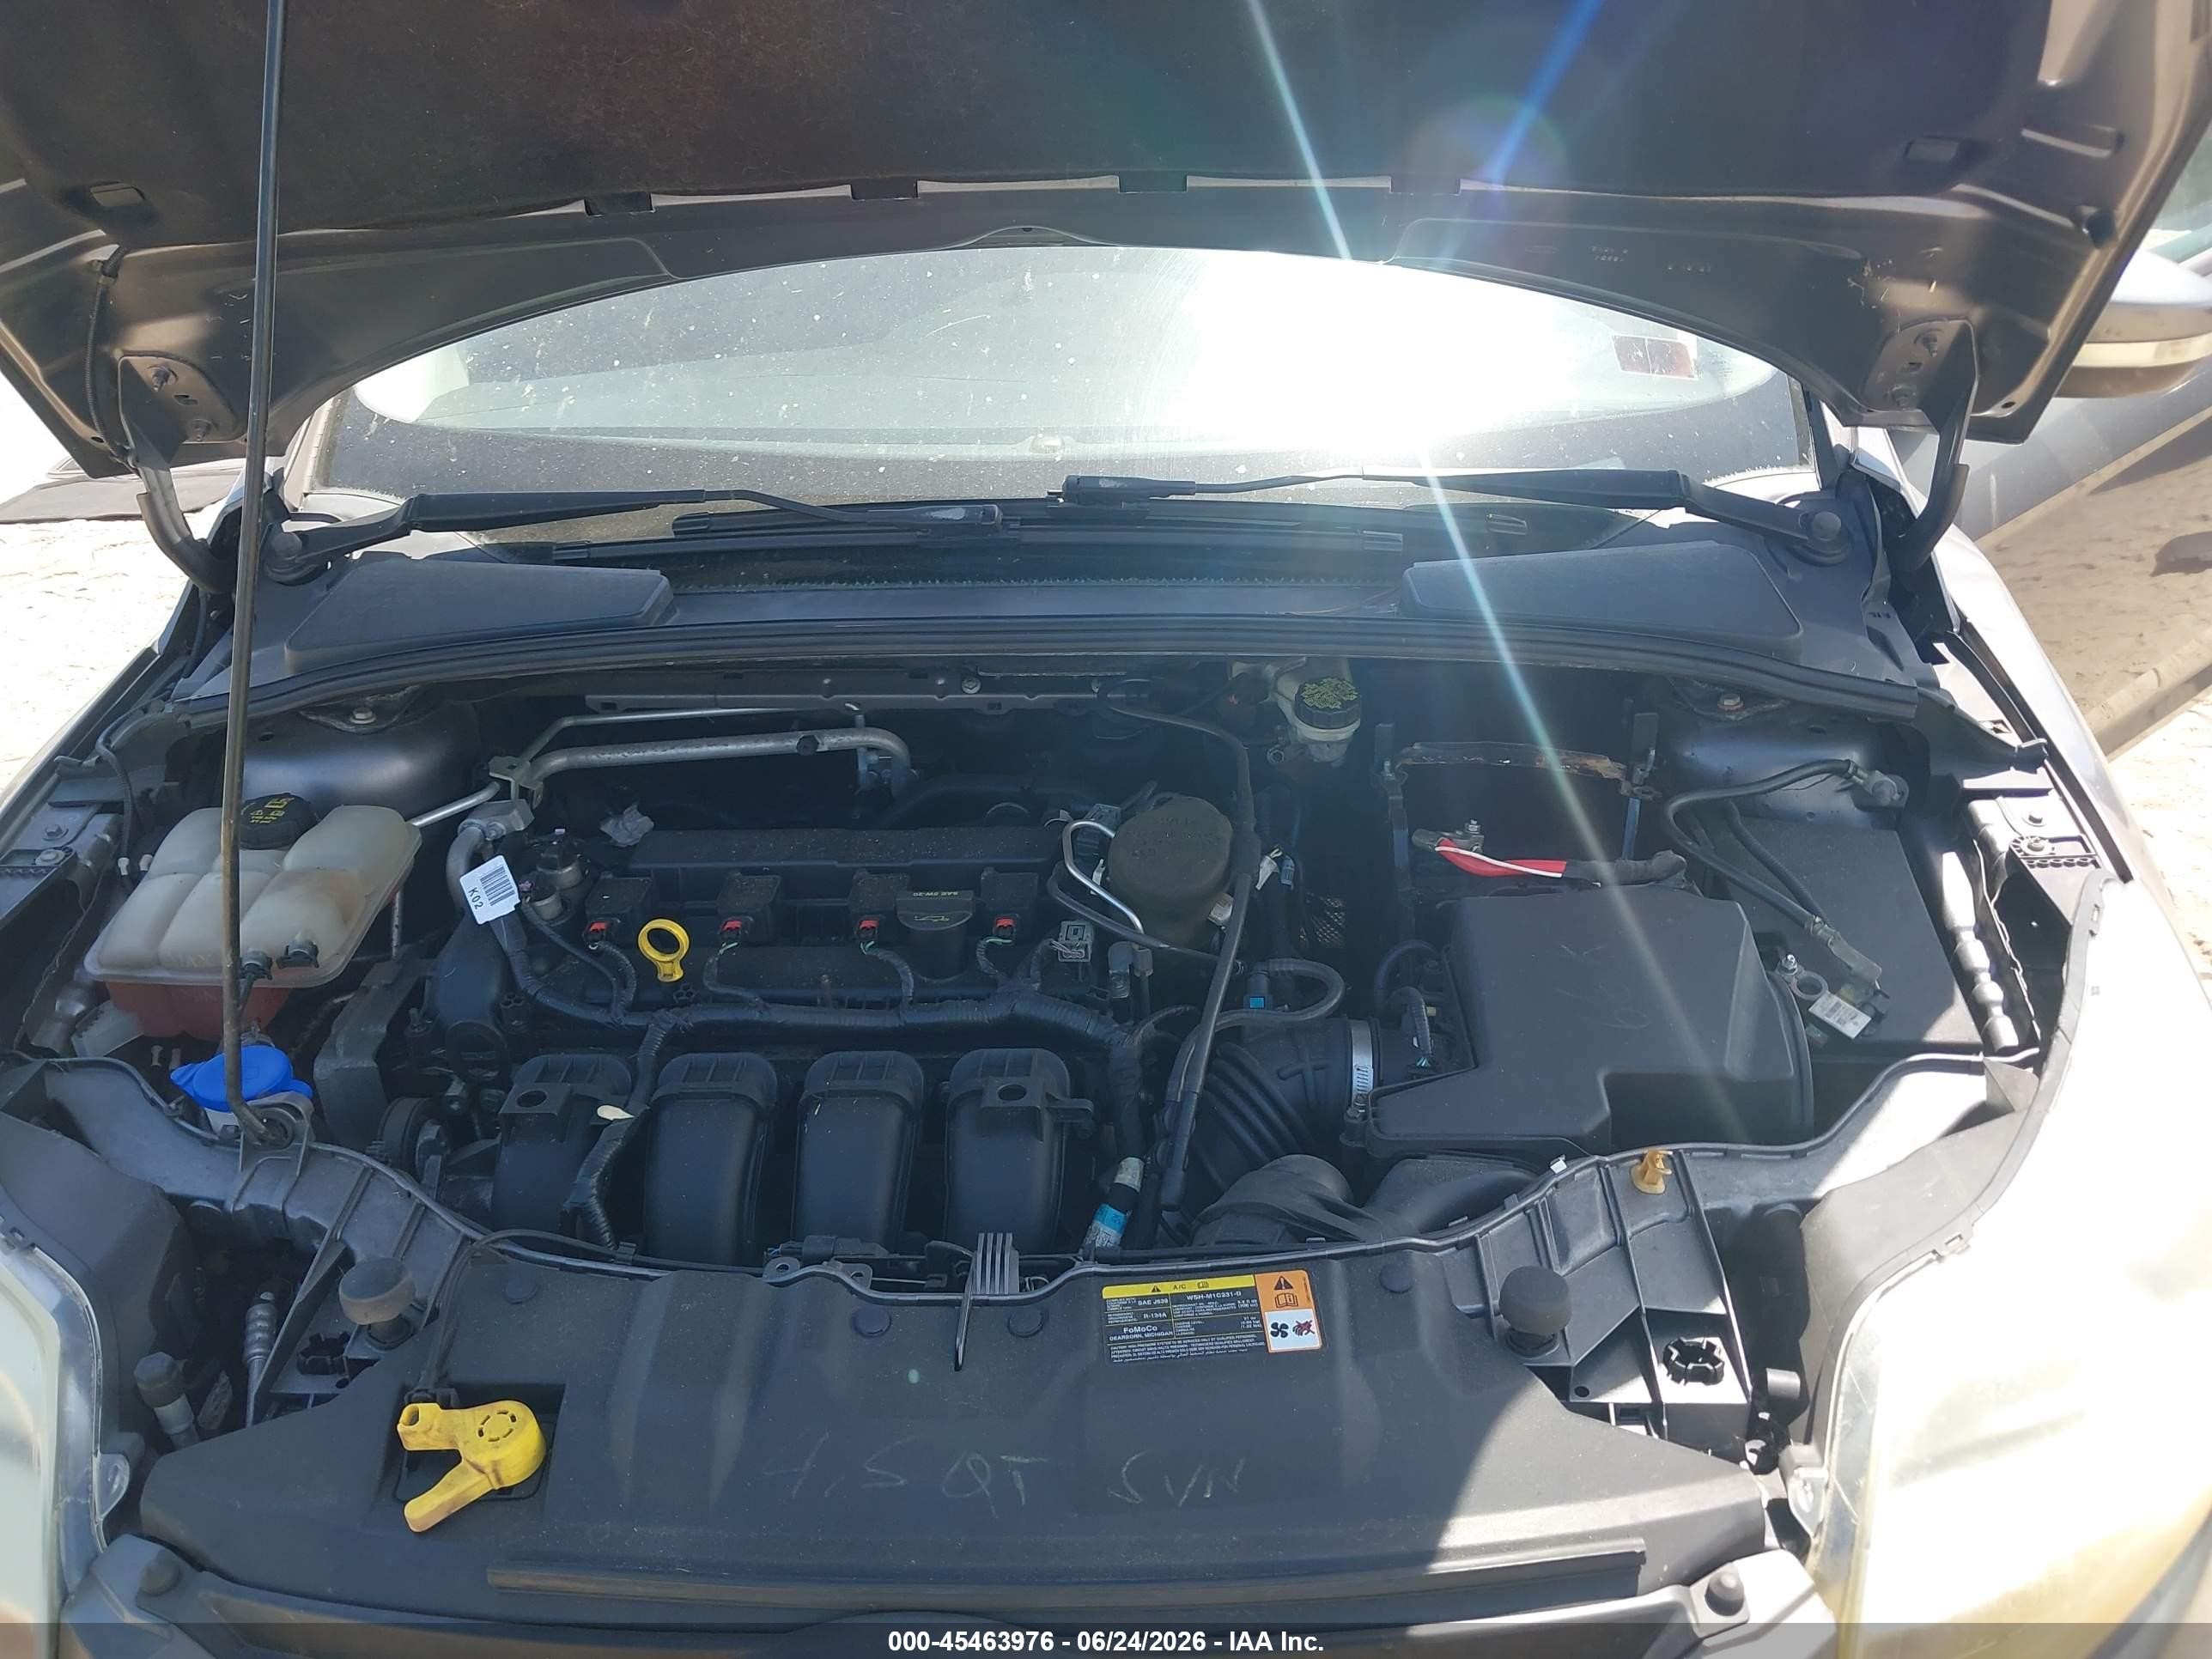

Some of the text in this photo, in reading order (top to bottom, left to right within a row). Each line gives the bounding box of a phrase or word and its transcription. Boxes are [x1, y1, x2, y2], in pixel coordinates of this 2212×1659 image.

[468, 887, 484, 910] K02
[1123, 1325, 1158, 1334] FoMoCo
[939, 1449, 1049, 1518] QT
